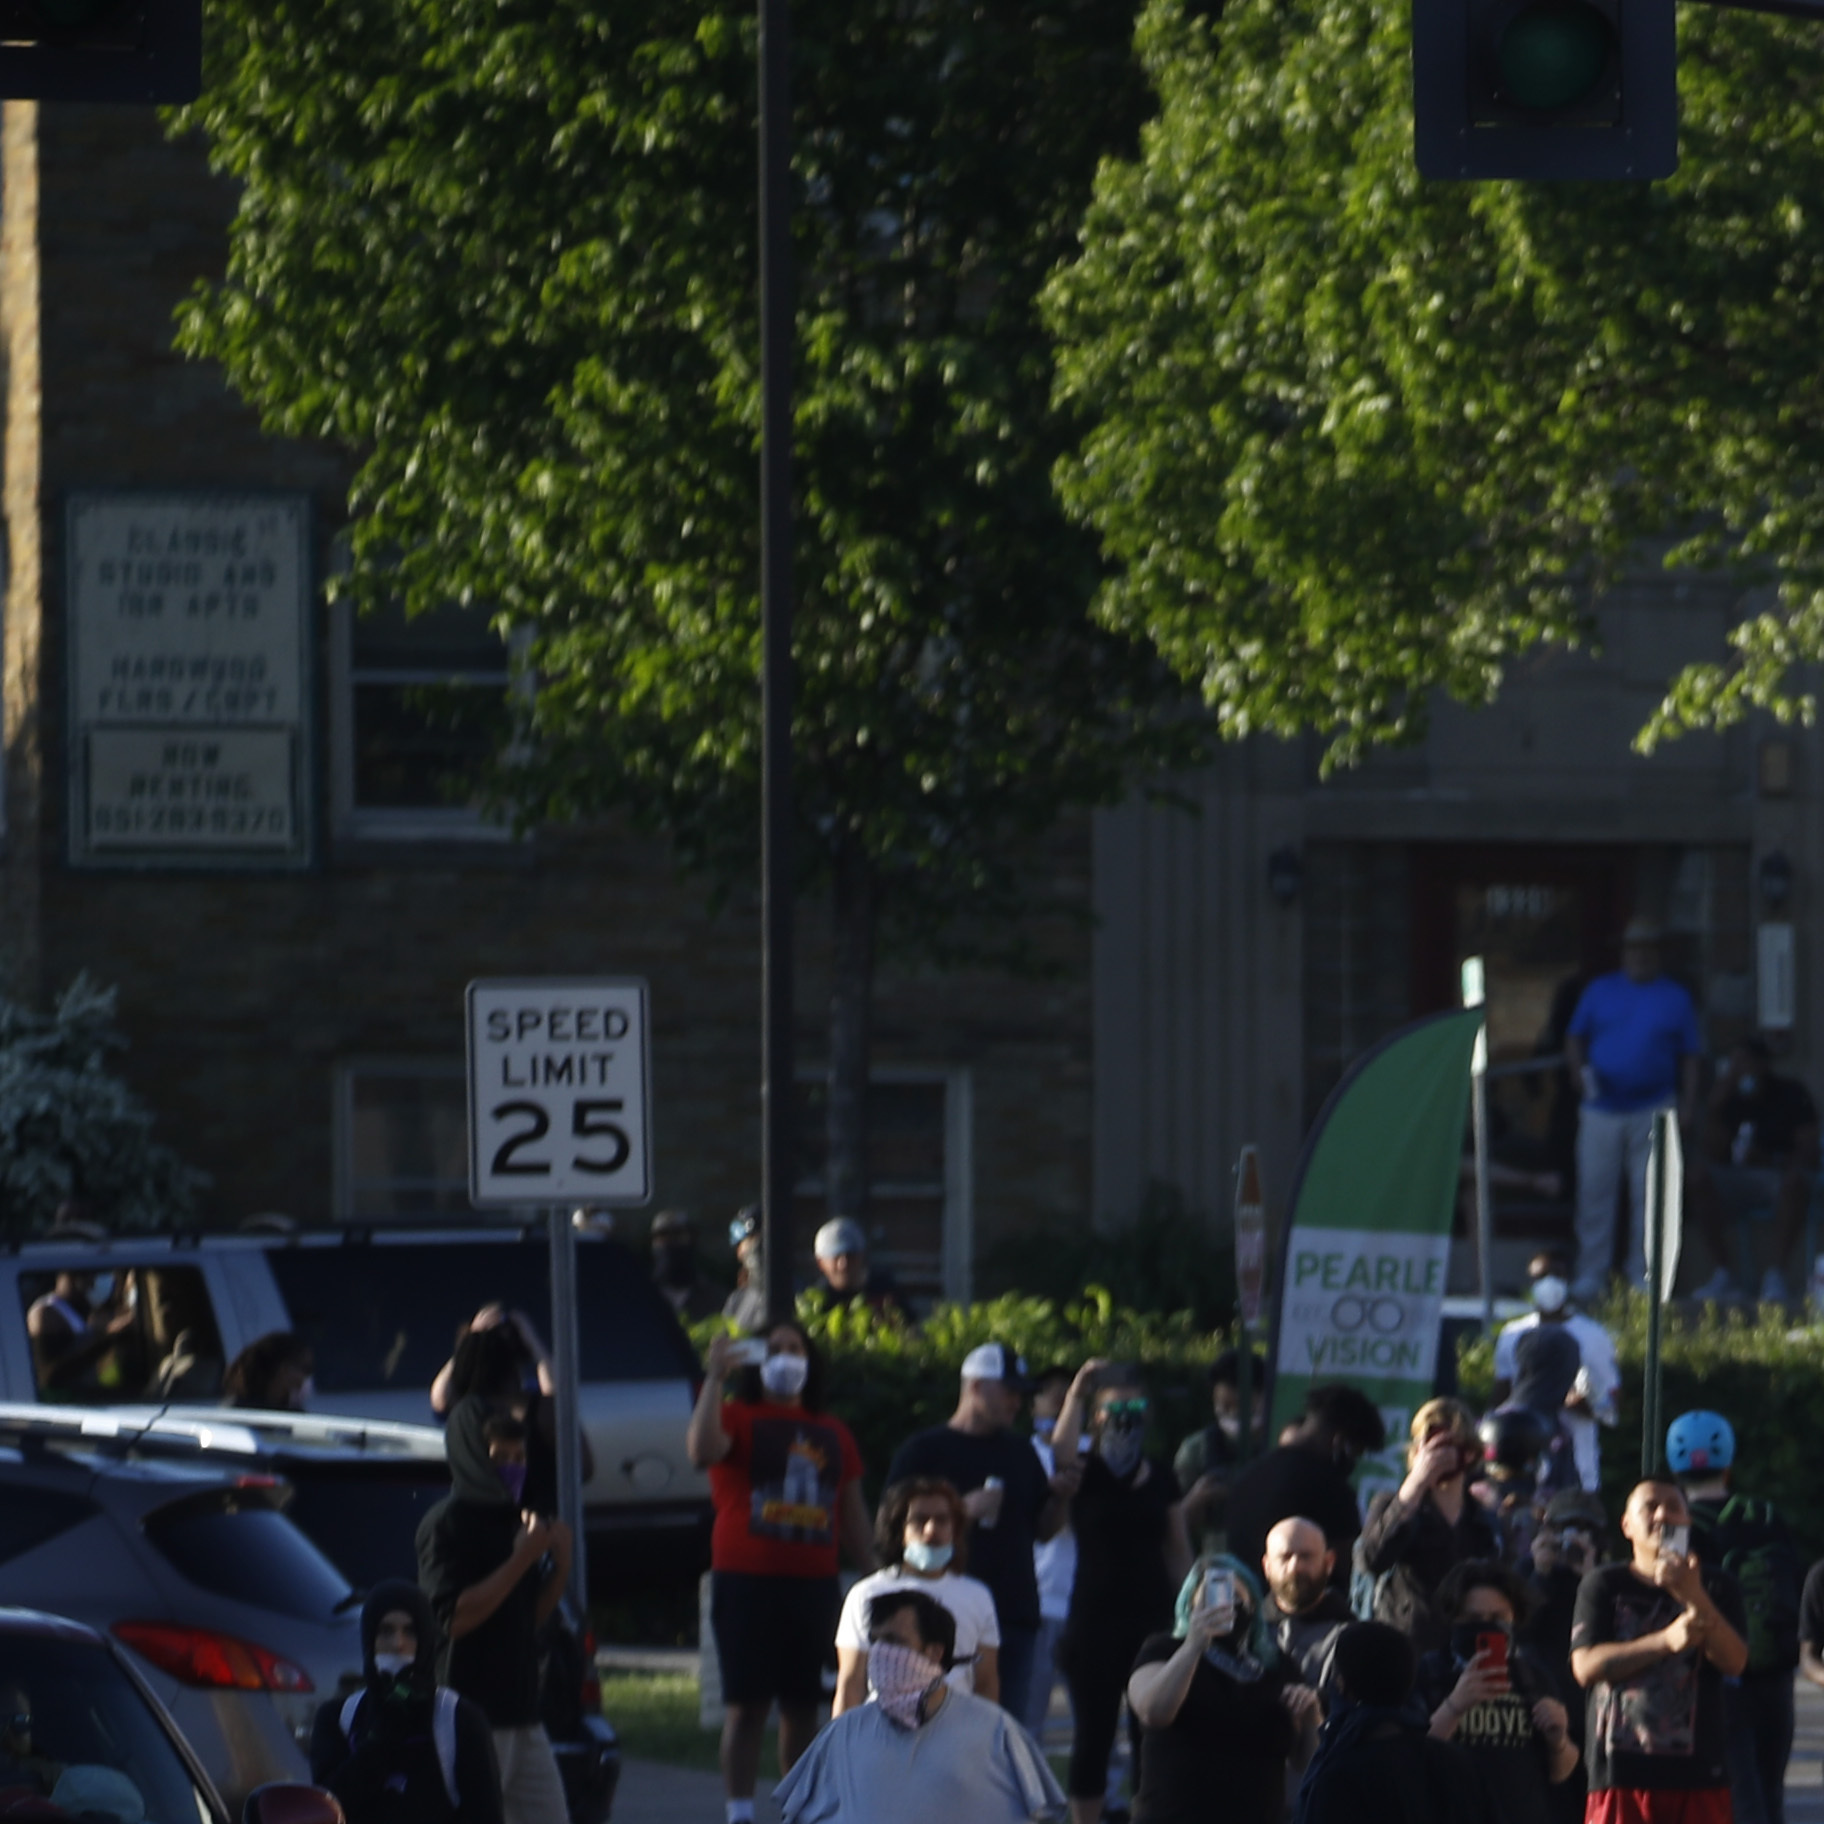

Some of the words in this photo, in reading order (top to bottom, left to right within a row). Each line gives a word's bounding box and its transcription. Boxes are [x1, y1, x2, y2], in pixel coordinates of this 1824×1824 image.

[99, 560, 201, 588] STUDIO
[186, 592, 260, 620] APTS
[111, 653, 268, 682] HARDWOOD
[161, 740, 219, 768] NOW
[129, 771, 251, 799] RENTING
[487, 1006, 630, 1042] SPEED
[503, 1053, 613, 1088] LIMIT
[491, 1101, 630, 1177] 25
[1294, 1252, 1441, 1294] PEARLE
[1305, 1333, 1423, 1370] VISION
